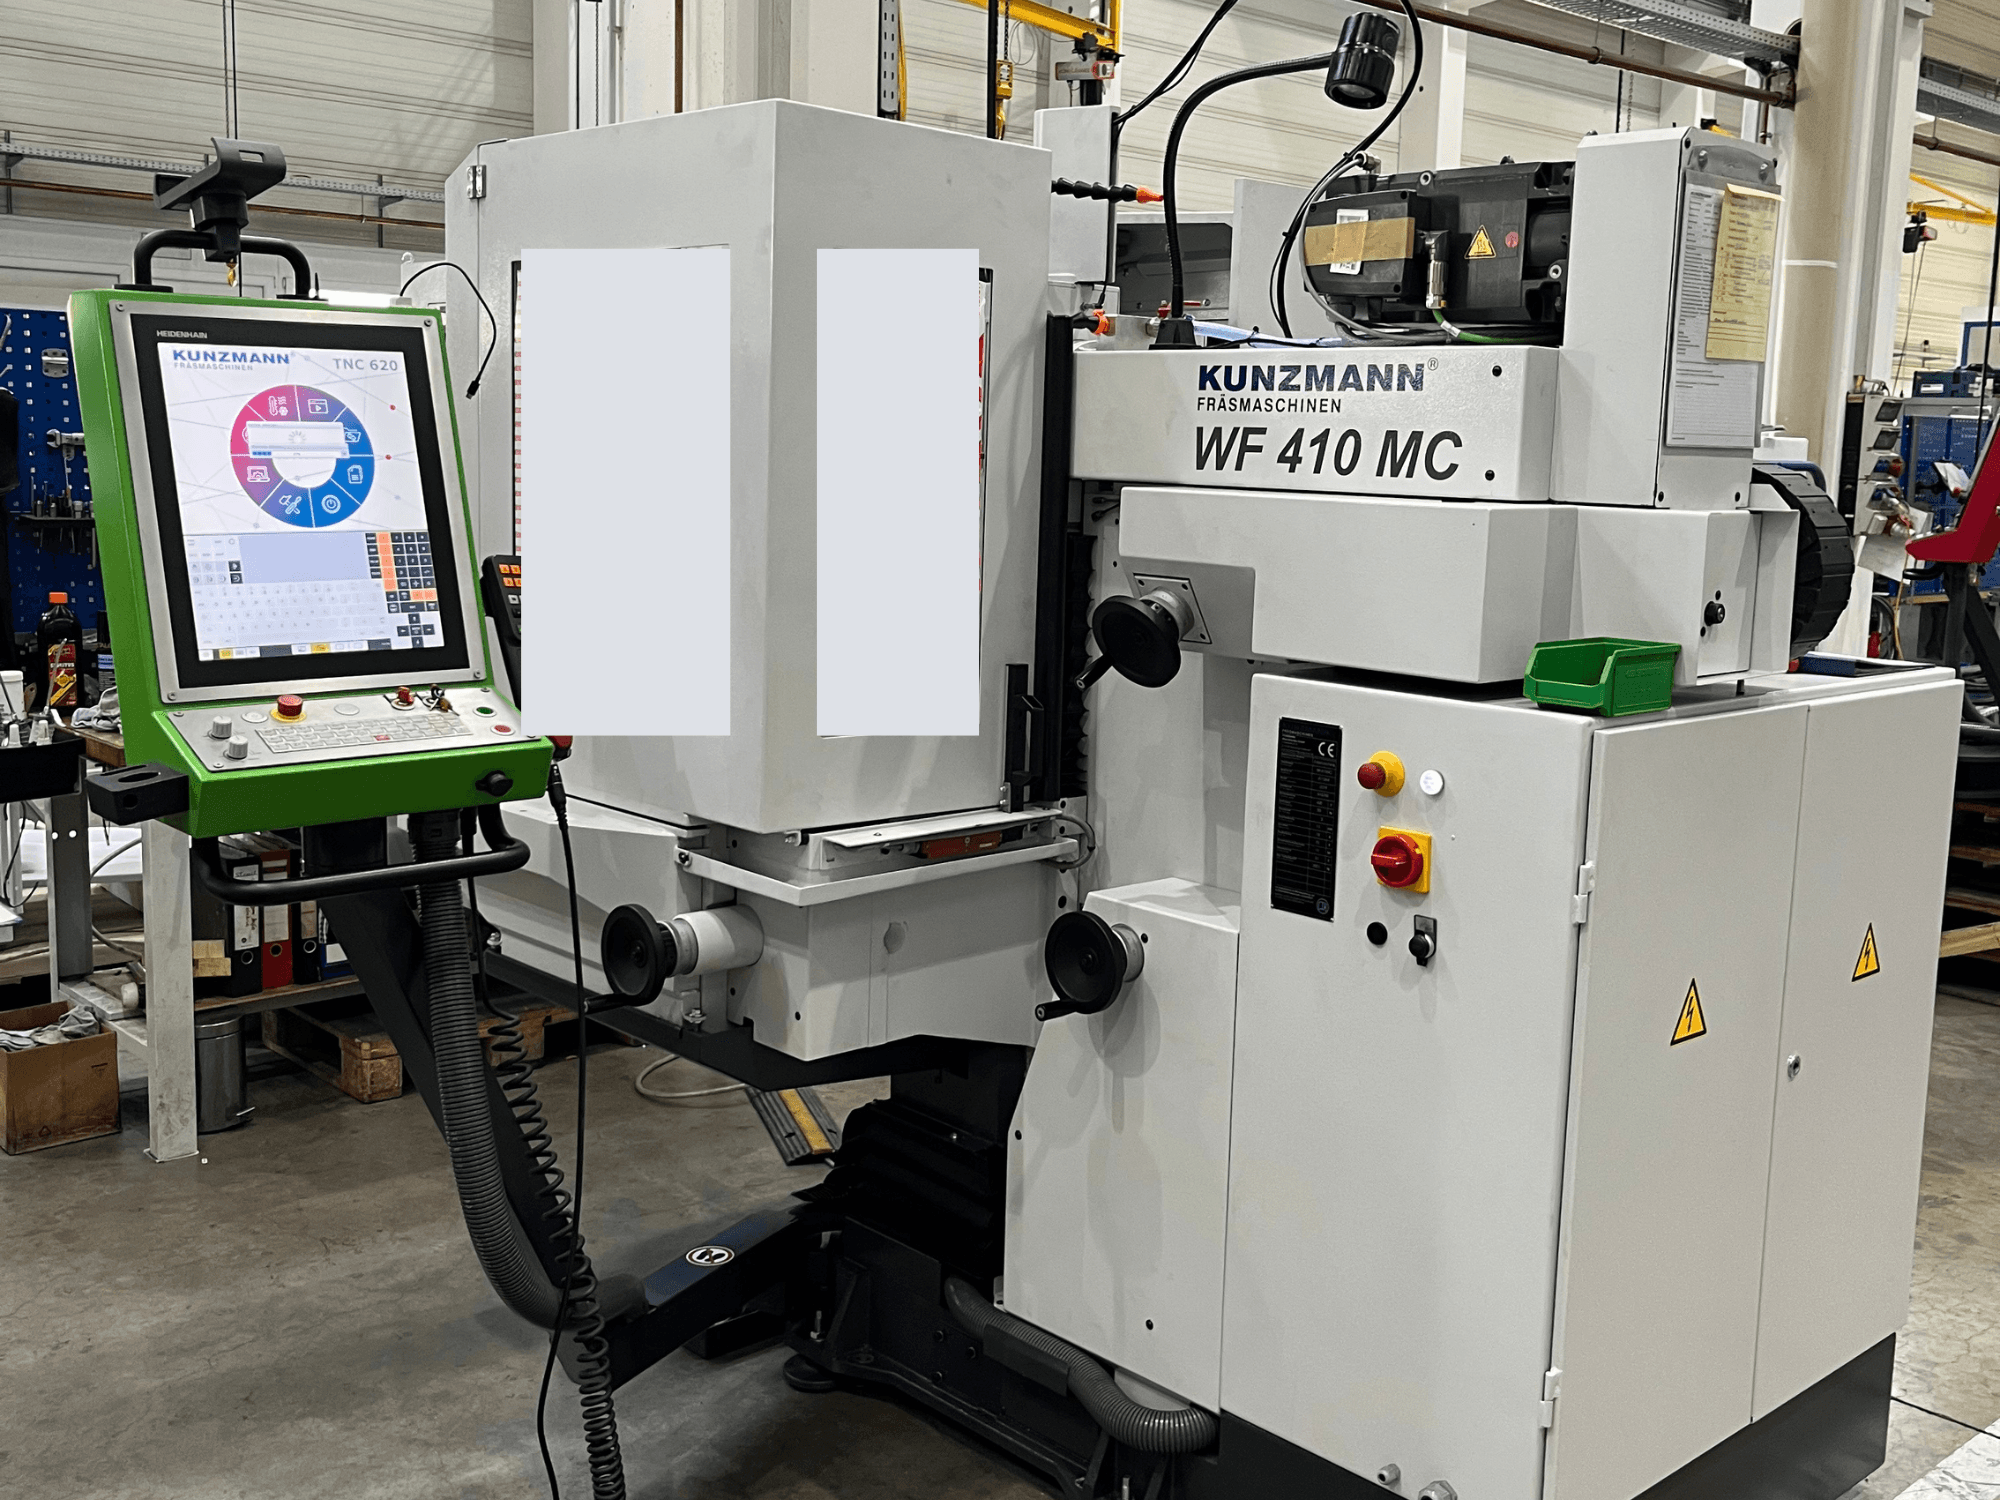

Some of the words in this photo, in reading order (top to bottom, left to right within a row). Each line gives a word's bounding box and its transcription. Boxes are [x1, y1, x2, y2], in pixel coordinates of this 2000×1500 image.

[156, 329, 208, 339] HEIDENHAIN
[332, 357, 365, 371] TNC
[369, 359, 398, 372] 620
[1197, 393, 1342, 413] FRÄSMASCHINEN
[1196, 426, 1267, 471] WF
[1276, 427, 1362, 476] 410
[1375, 429, 1463, 481] MC
